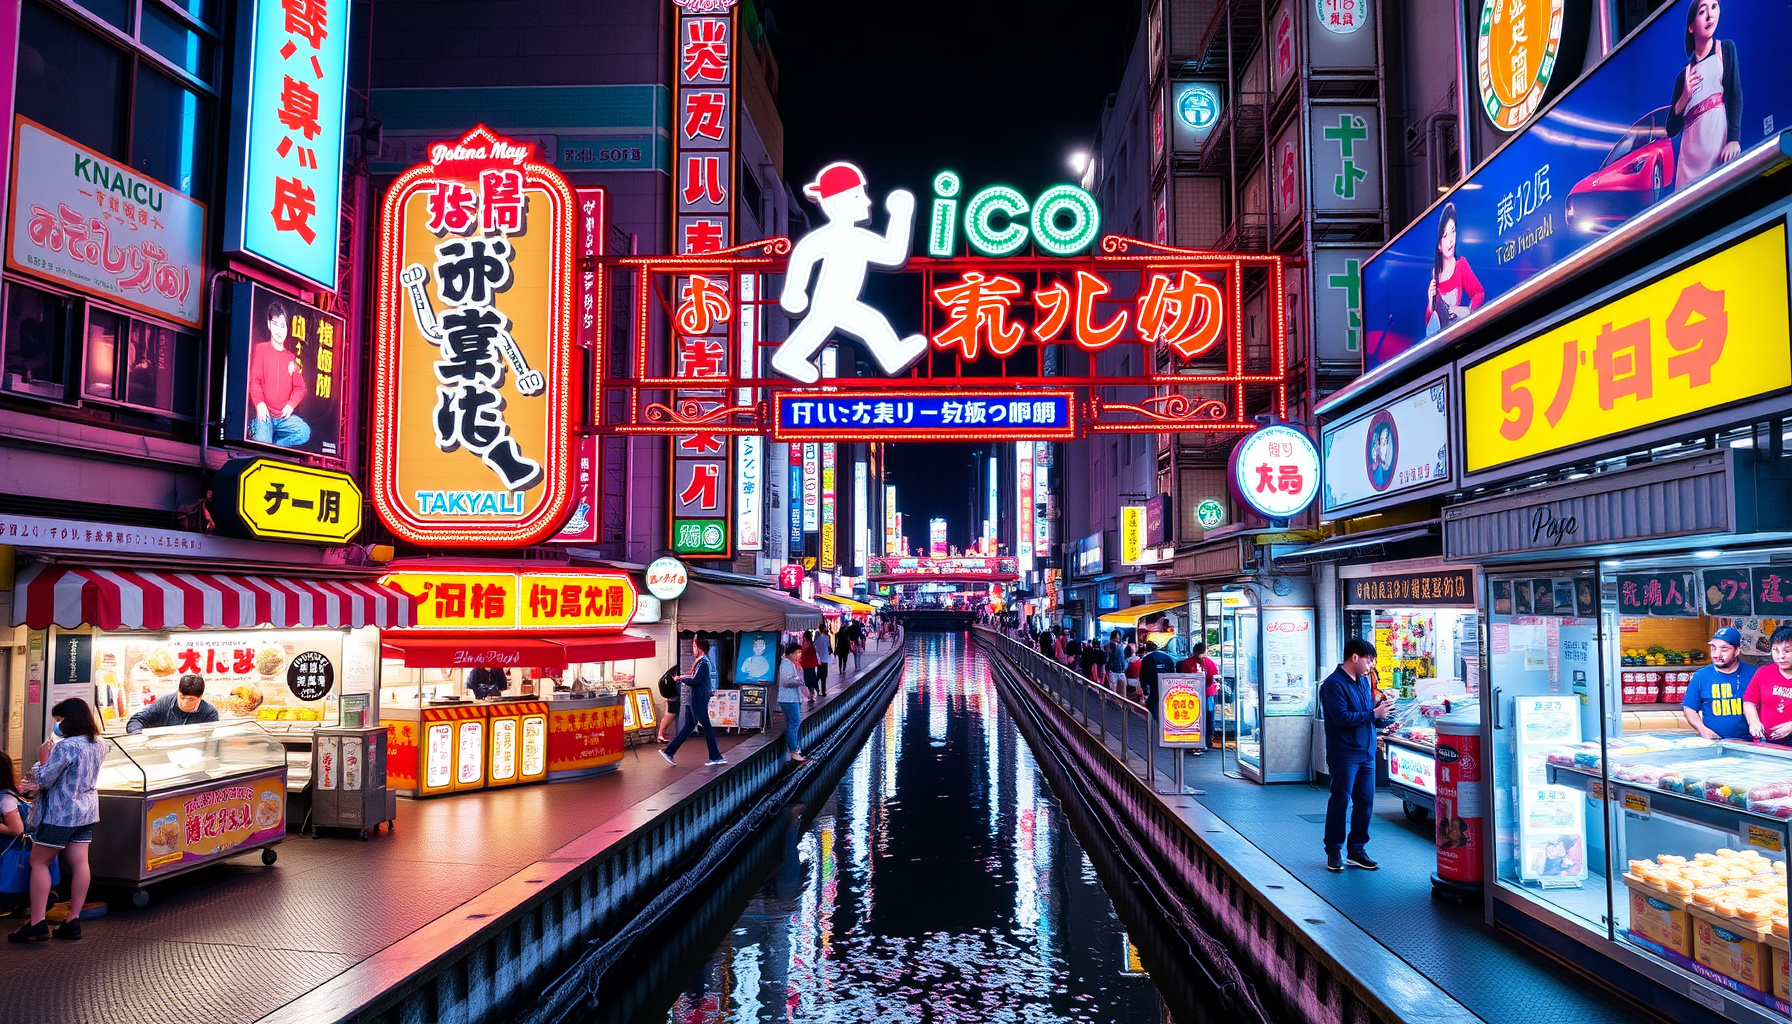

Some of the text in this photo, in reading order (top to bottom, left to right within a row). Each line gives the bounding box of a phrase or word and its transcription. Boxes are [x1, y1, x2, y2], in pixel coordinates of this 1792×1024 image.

[74, 152, 163, 212] KNAICU
[928, 170, 1100, 258] ico
[415, 490, 525, 516] TAKYALI
